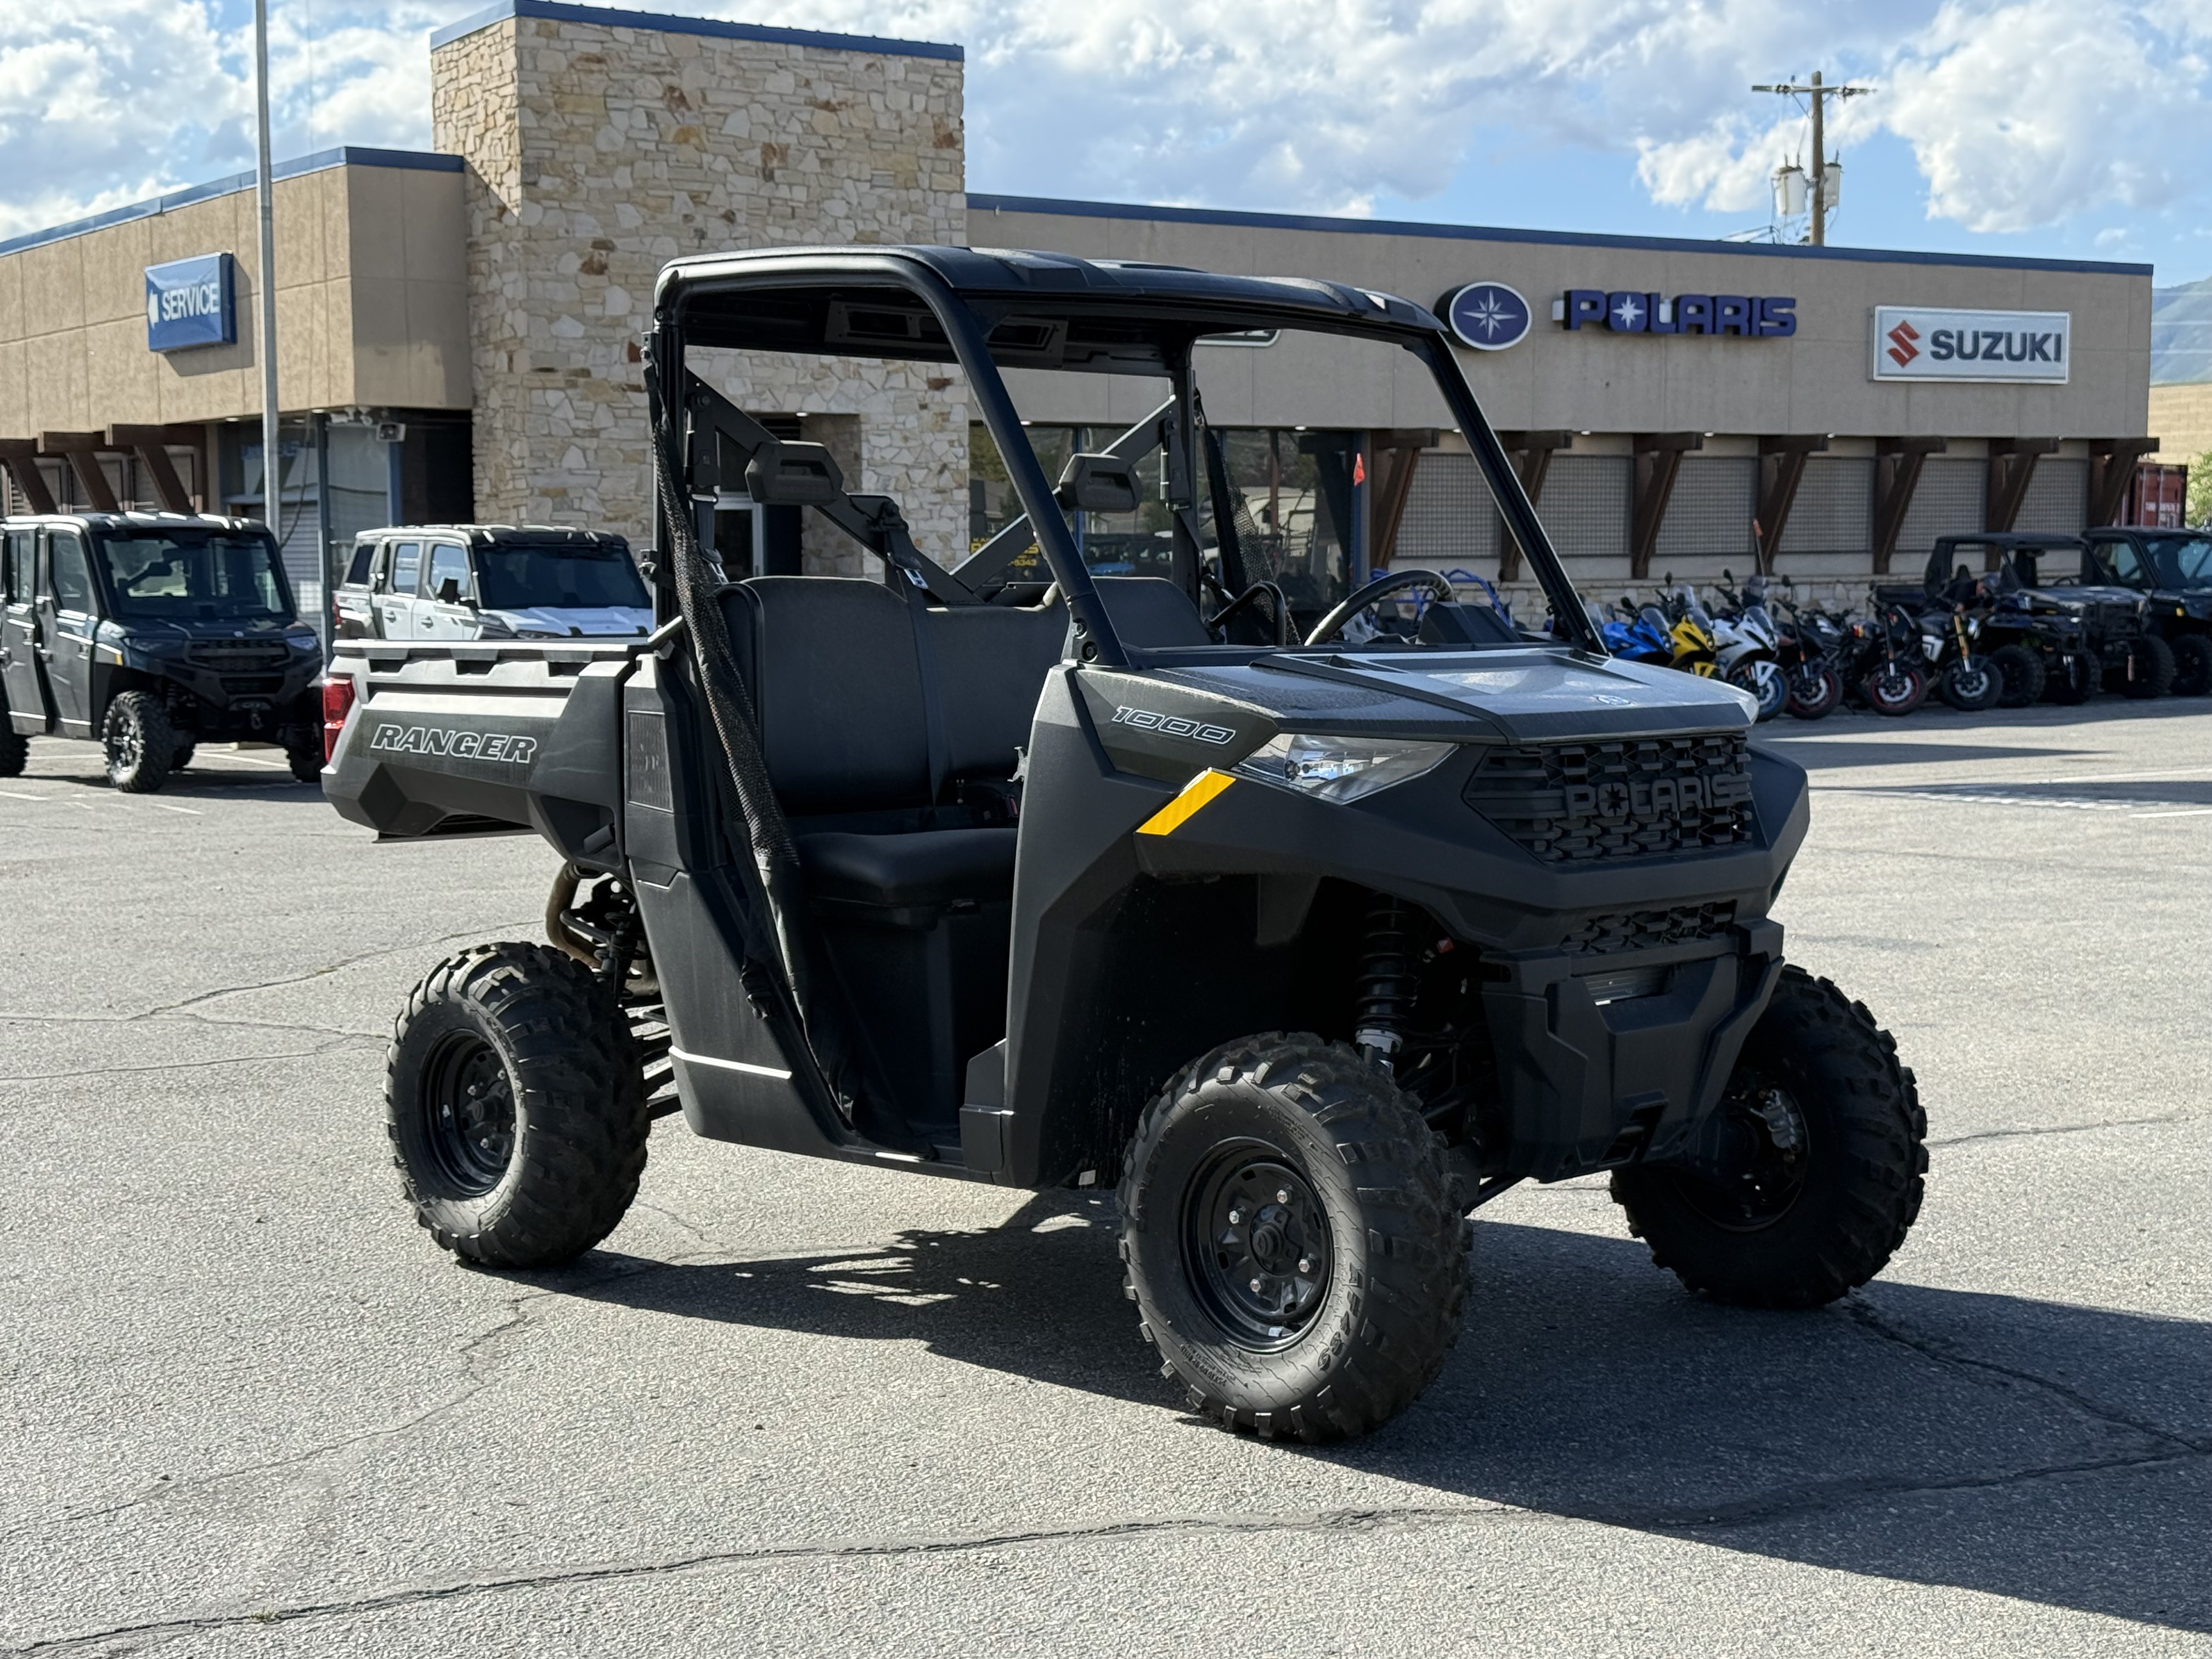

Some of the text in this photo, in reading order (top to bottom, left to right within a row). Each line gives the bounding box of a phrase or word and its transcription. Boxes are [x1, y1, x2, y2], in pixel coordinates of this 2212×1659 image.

[162, 282, 219, 321] SERVICE
[1564, 289, 1796, 337] POLARIS
[1929, 330, 2062, 363] SUZUKI
[370, 723, 538, 764] RANGER
[1111, 705, 1237, 745] 1000
[1565, 772, 1751, 820] POLARIS
